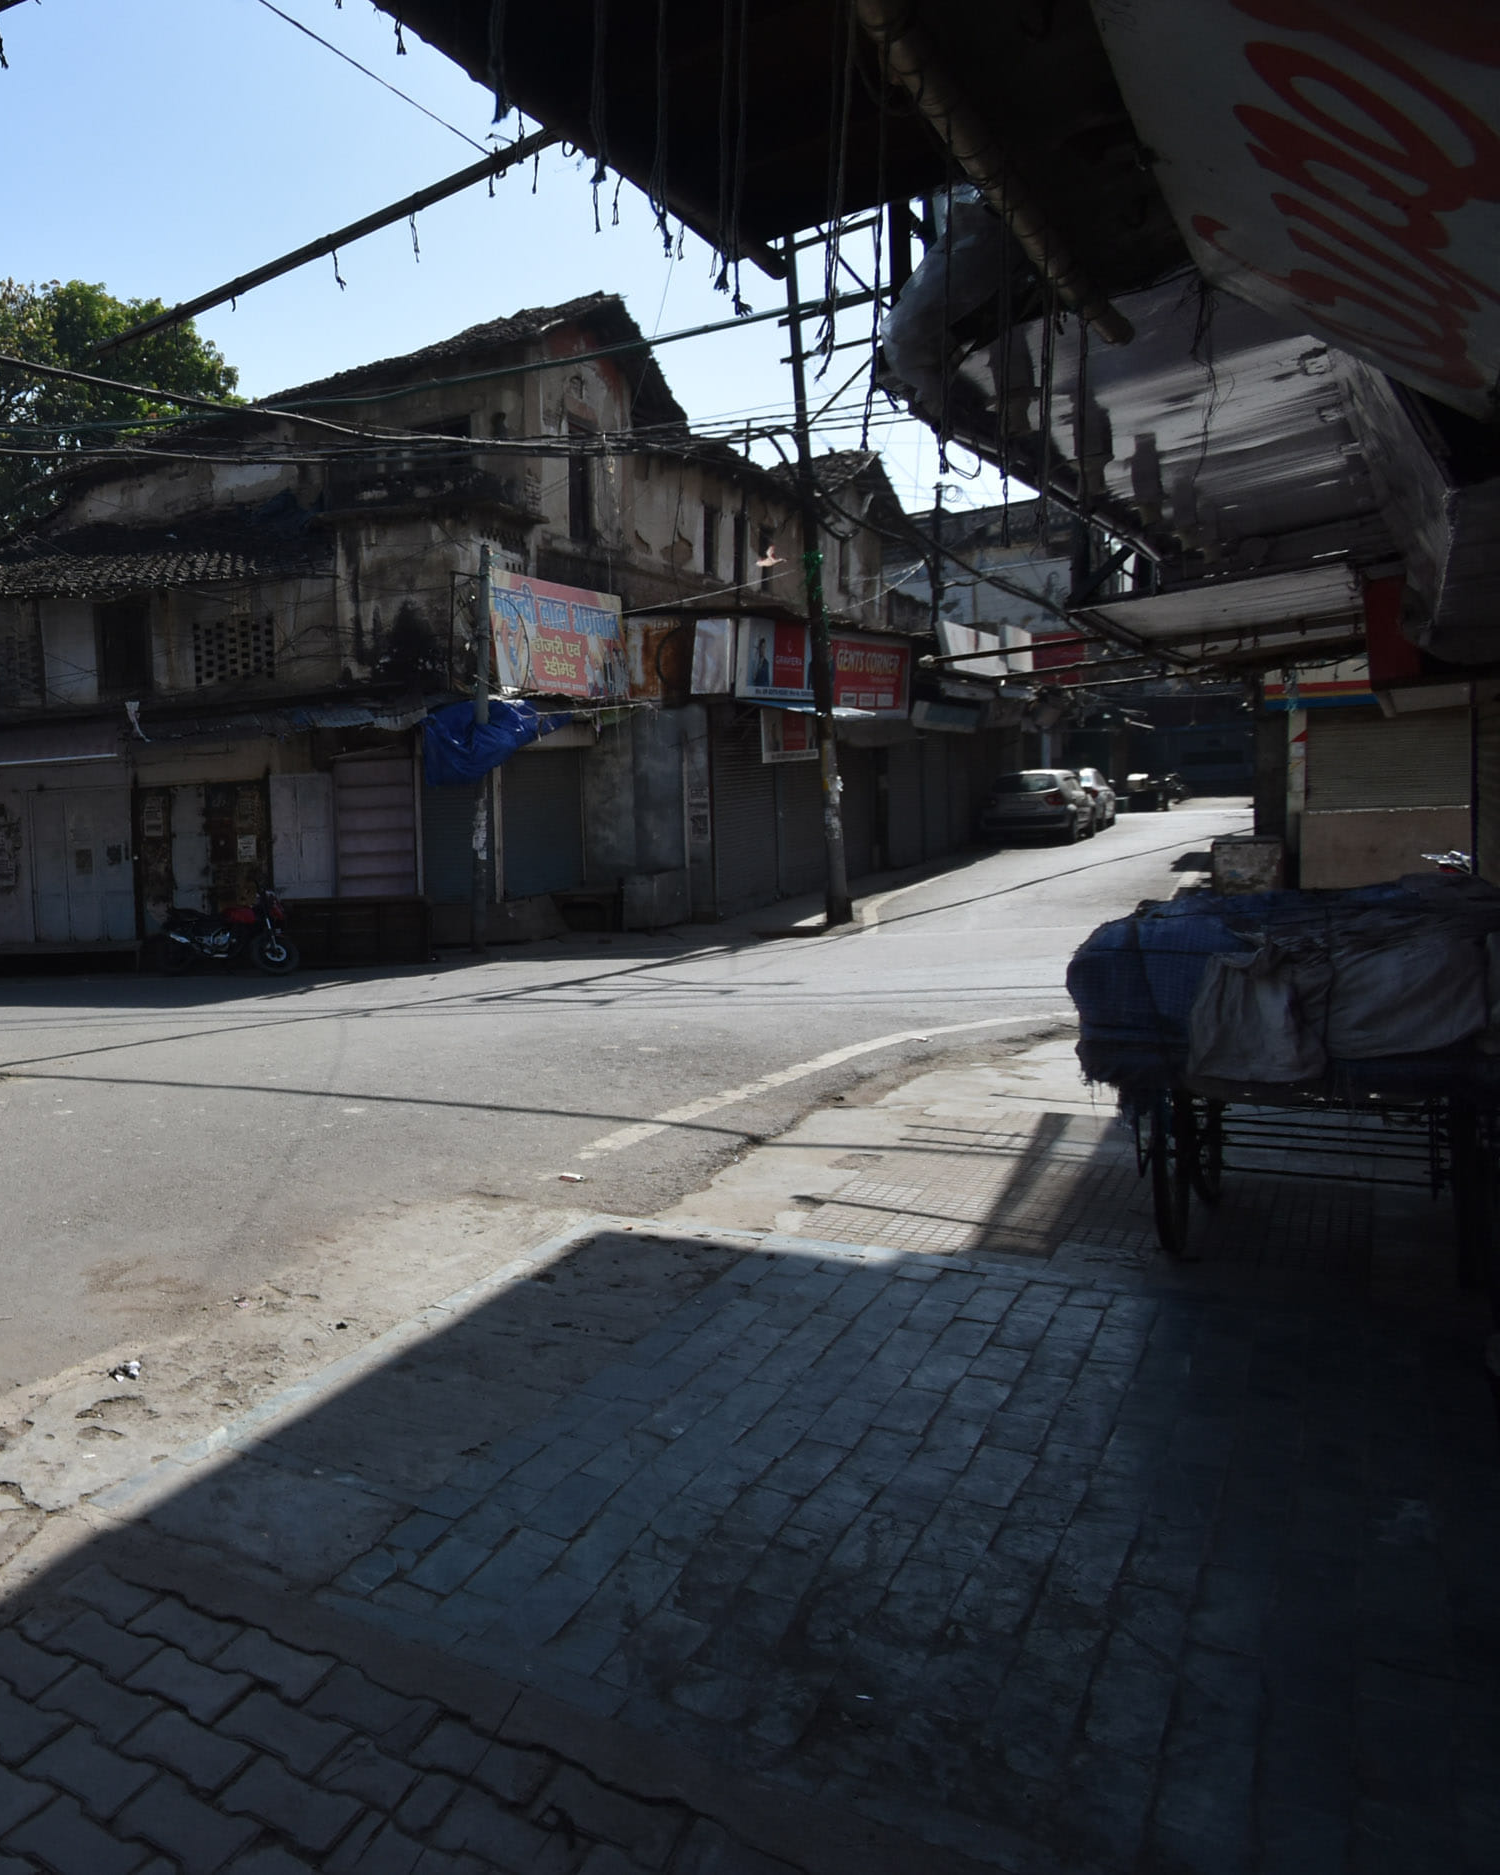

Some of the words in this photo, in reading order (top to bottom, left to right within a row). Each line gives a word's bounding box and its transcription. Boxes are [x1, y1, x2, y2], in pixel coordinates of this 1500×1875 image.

[1190, 0, 1500, 389] Supe
[565, 640, 582, 657] एवं
[542, 656, 578, 679] रेडीमेड
[836, 648, 865, 673] GENTS
[866, 652, 901, 676] CORNER
